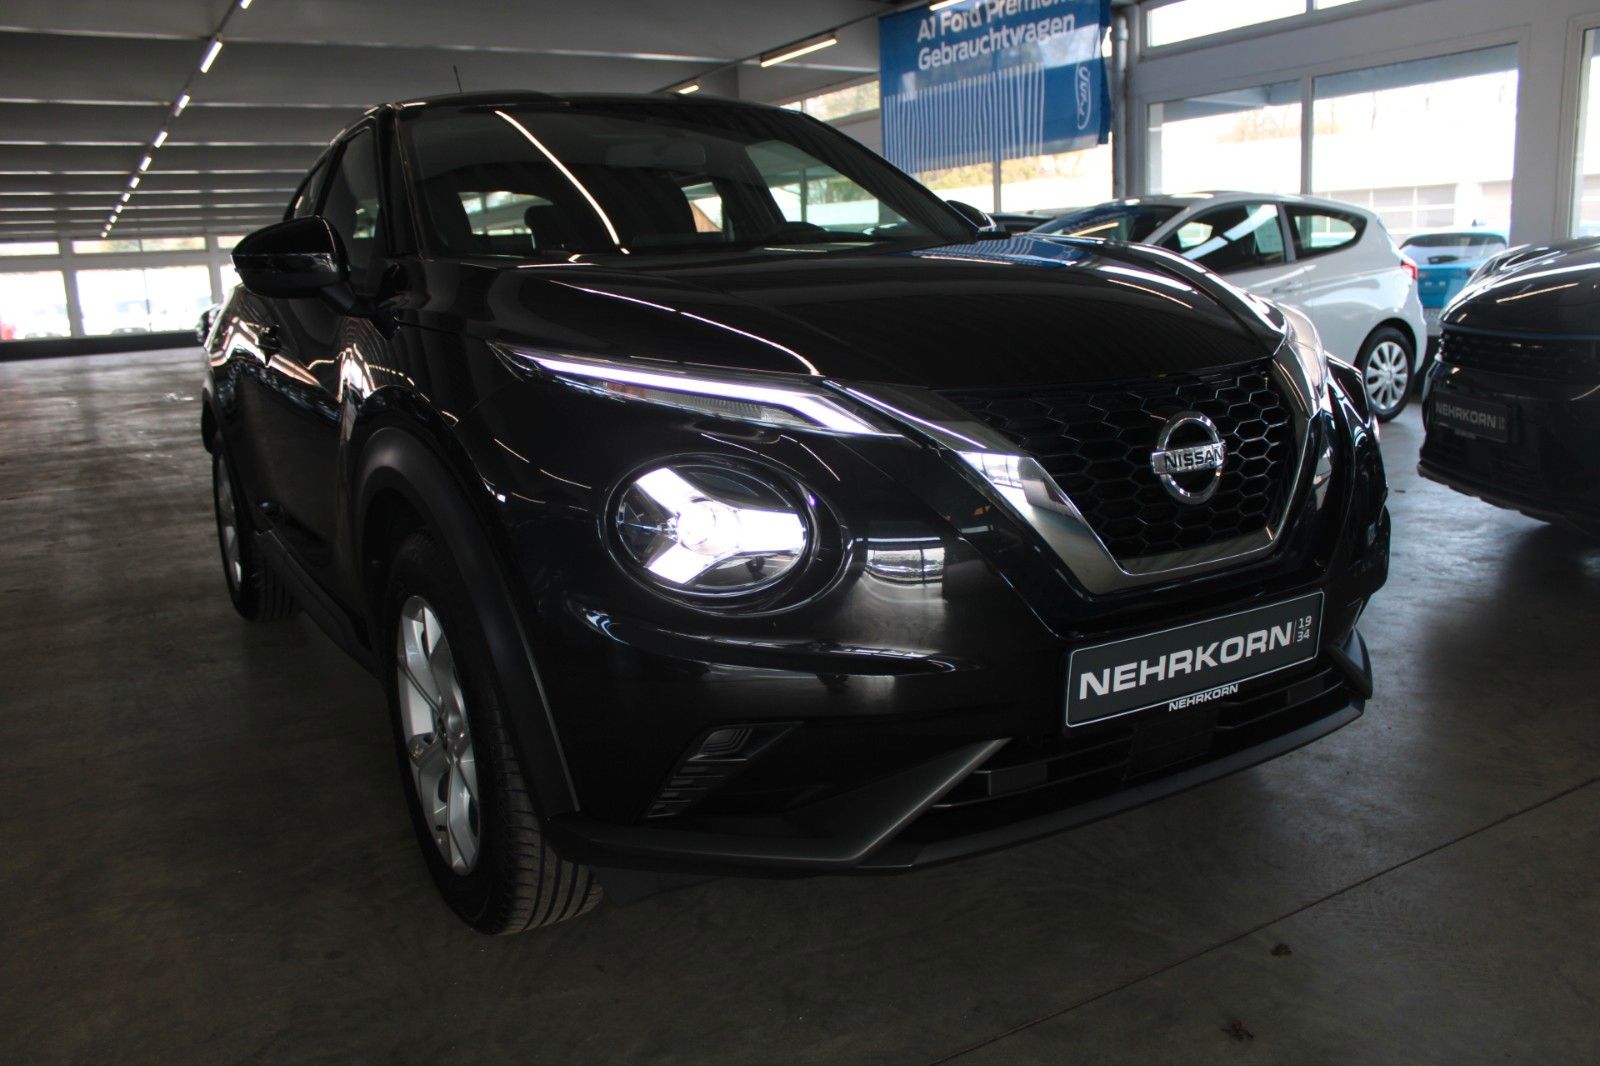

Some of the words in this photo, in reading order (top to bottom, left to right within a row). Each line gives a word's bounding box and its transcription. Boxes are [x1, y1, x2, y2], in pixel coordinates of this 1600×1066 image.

[940, 2, 982, 36] Ford
[985, 0, 1067, 23] Premi
[917, 13, 1075, 70] Gebrauchtwagen
[1435, 402, 1497, 429] NEHRKORN
[1164, 447, 1223, 468] NISSAN
[1297, 628, 1310, 642] 34
[1299, 615, 1312, 629] 19
[1079, 621, 1293, 700] NEHRKORN
[1168, 683, 1239, 712] NEHRKORN
